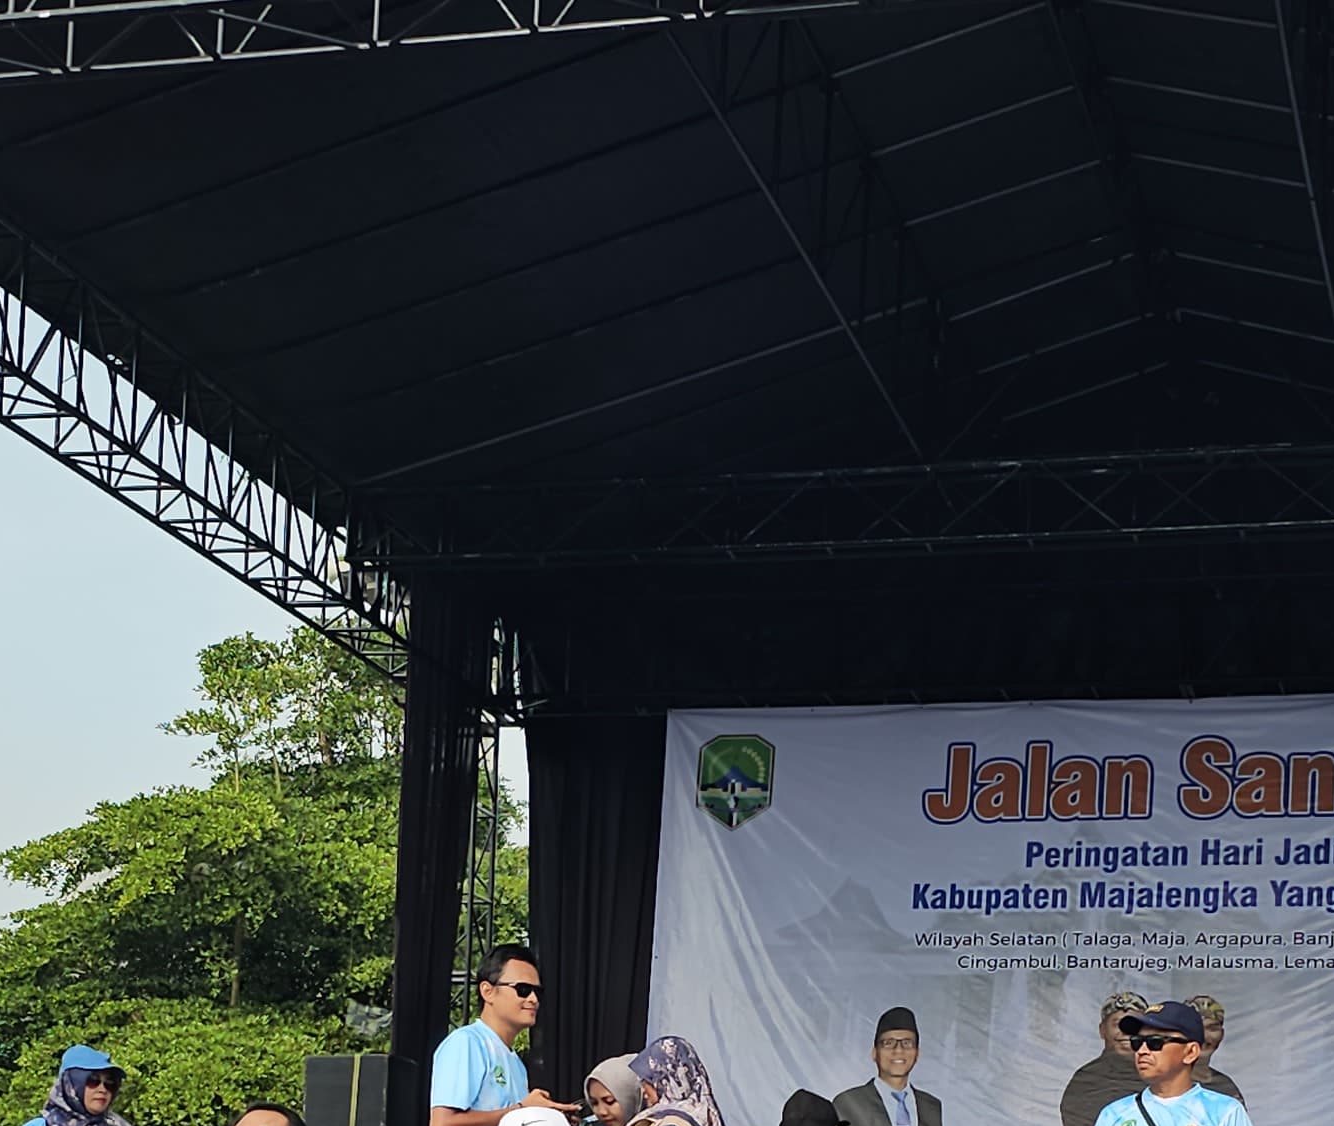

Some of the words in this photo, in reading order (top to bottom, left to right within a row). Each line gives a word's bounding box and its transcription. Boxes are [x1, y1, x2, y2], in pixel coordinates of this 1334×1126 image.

[922, 739, 1155, 825] Jalan
[1025, 840, 1188, 873] Peringatan
[1200, 838, 1264, 867] Hari
[911, 881, 1069, 916] Kabupaten
[1080, 879, 1259, 916] Majalengka
[915, 931, 984, 949] Wilayah
[989, 931, 1057, 946] Selatan
[1074, 931, 1136, 949] Talaga,
[1142, 931, 1189, 949] Maja,
[1195, 931, 1287, 949] Argapura,
[957, 954, 1061, 972] Cingambul,
[1067, 954, 1172, 972] Bantarujeg,
[1178, 954, 1279, 970] Malausma,
